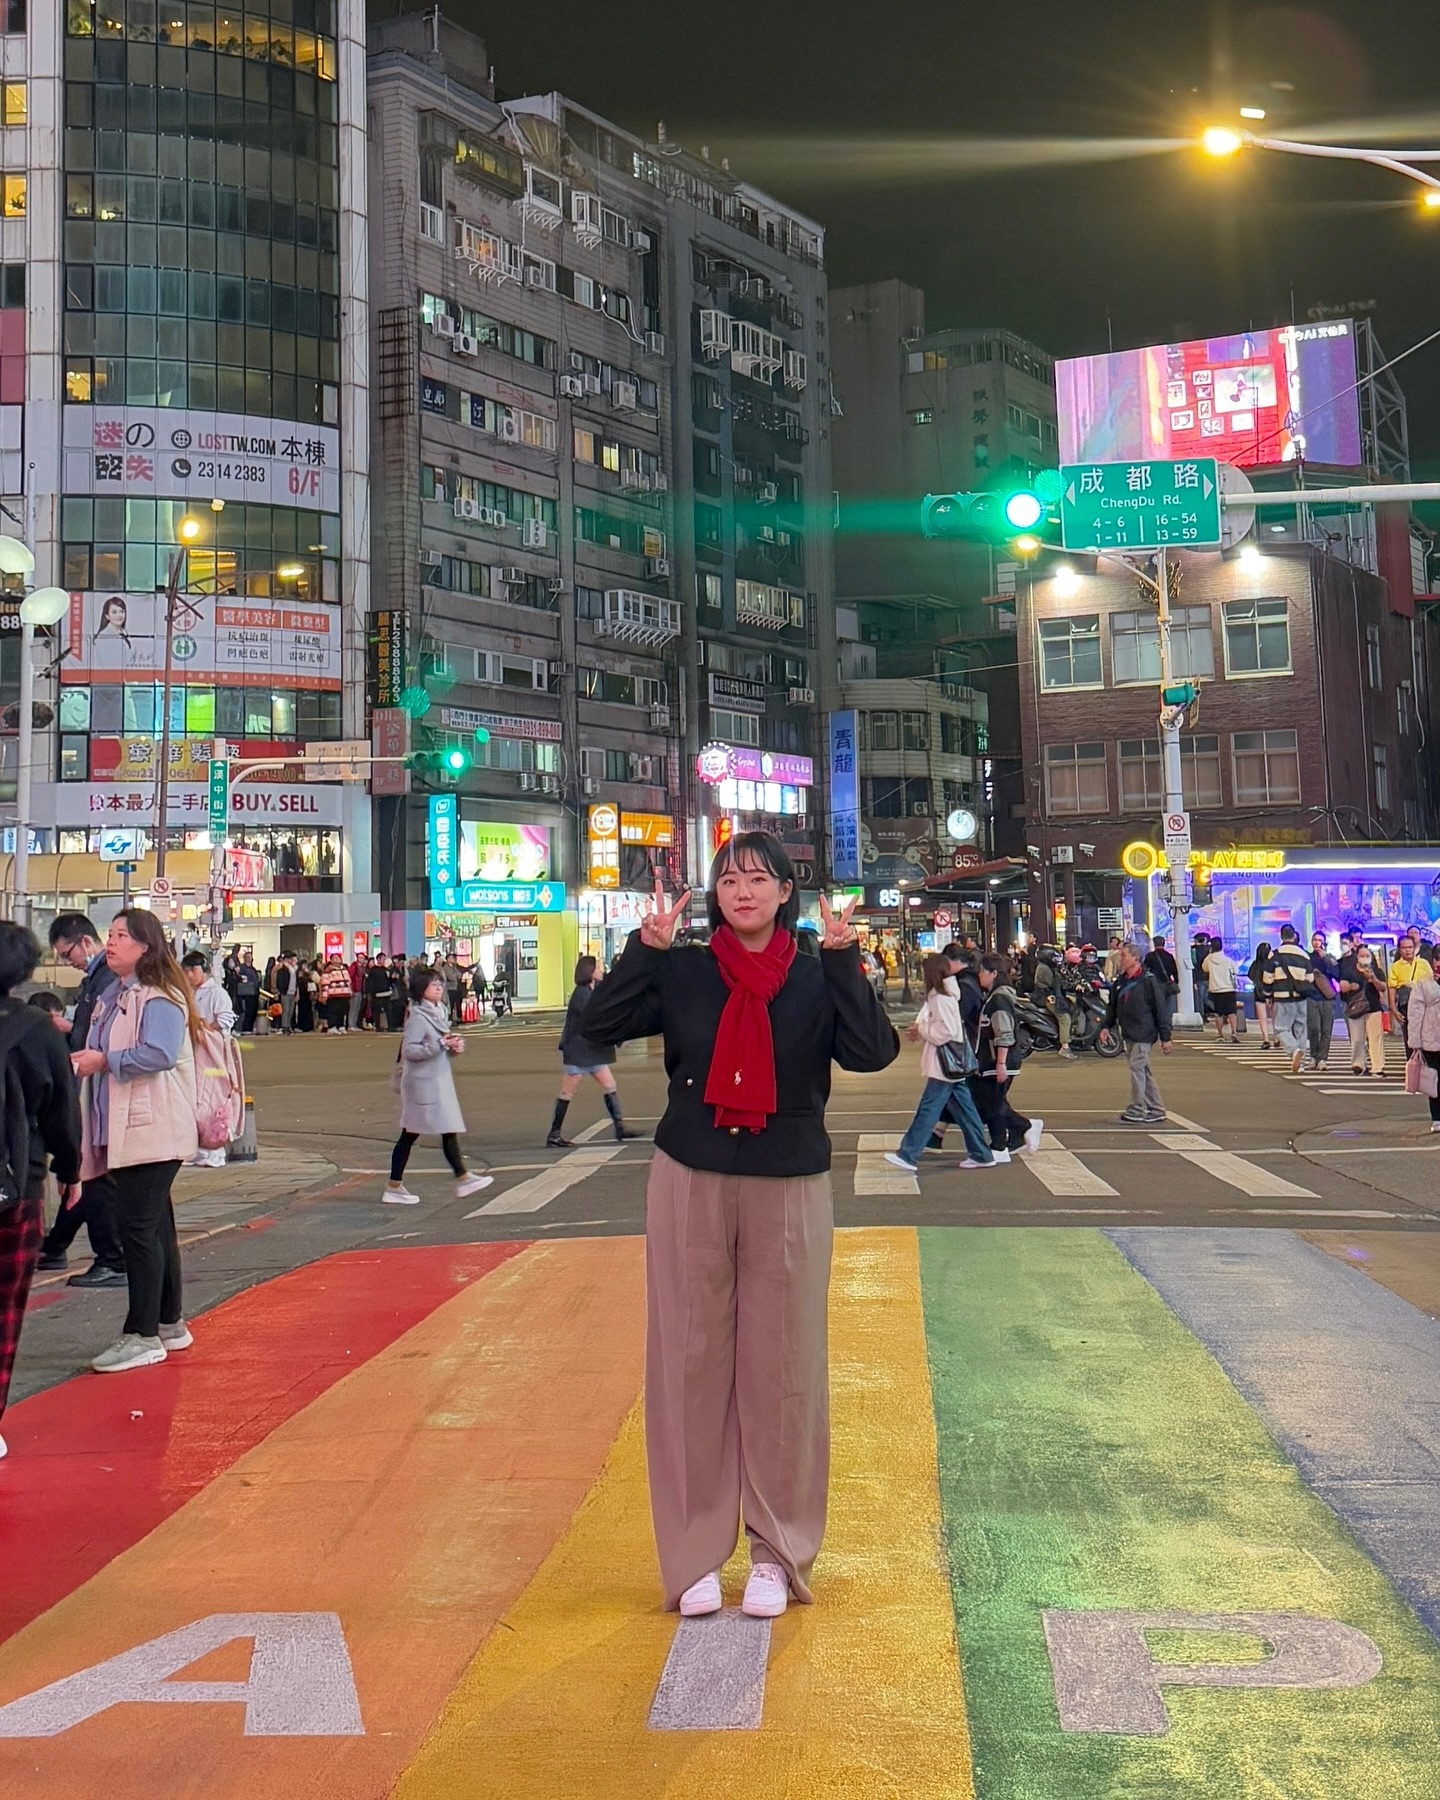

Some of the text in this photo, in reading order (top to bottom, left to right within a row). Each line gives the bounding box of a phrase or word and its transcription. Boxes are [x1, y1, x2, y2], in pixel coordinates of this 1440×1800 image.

[198, 433, 276, 455] LOSTTW.COM
[281, 436, 326, 466] 本棟
[288, 467, 321, 497] 6/F
[1080, 463, 1199, 494] 成都路
[1101, 495, 1182, 509] ChengDu Rd.
[222, 609, 276, 626] 醫學美容
[834, 729, 853, 774] 青龍
[232, 793, 271, 812] BUY
[281, 795, 319, 813] SELL
